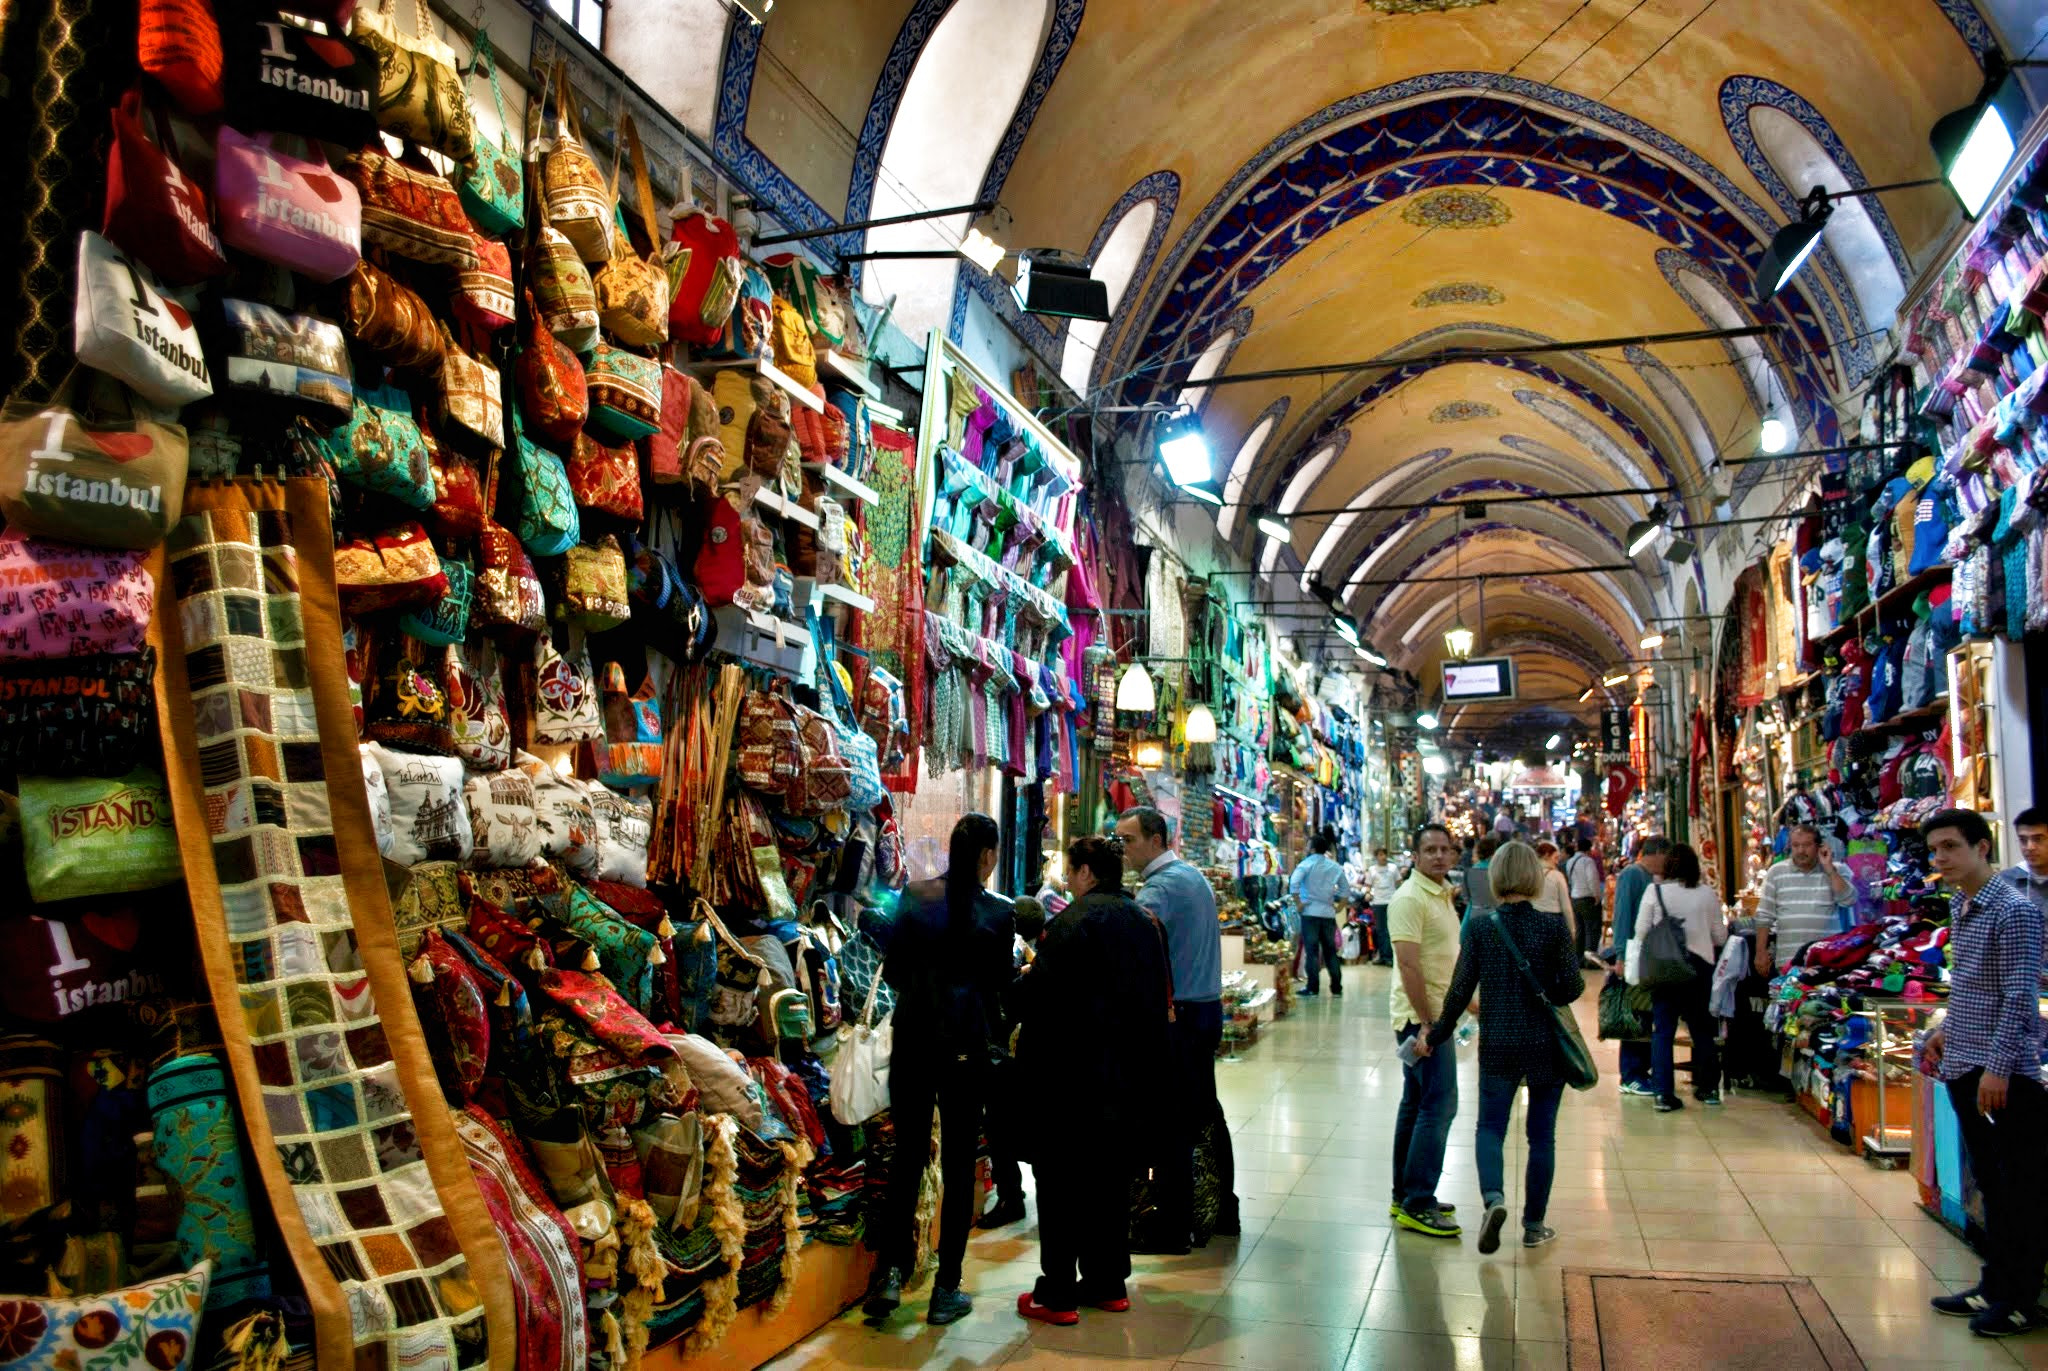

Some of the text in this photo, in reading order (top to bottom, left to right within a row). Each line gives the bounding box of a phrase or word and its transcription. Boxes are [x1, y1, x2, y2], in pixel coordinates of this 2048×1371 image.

[256, 21, 298, 61] I
[260, 57, 370, 111] istanbul
[257, 145, 293, 190] I
[255, 185, 361, 252] istanbul
[113, 254, 160, 318] I
[133, 308, 208, 384] istanbul
[31, 411, 79, 462] I
[25, 461, 161, 513] istanbul
[30, 914, 91, 977] I
